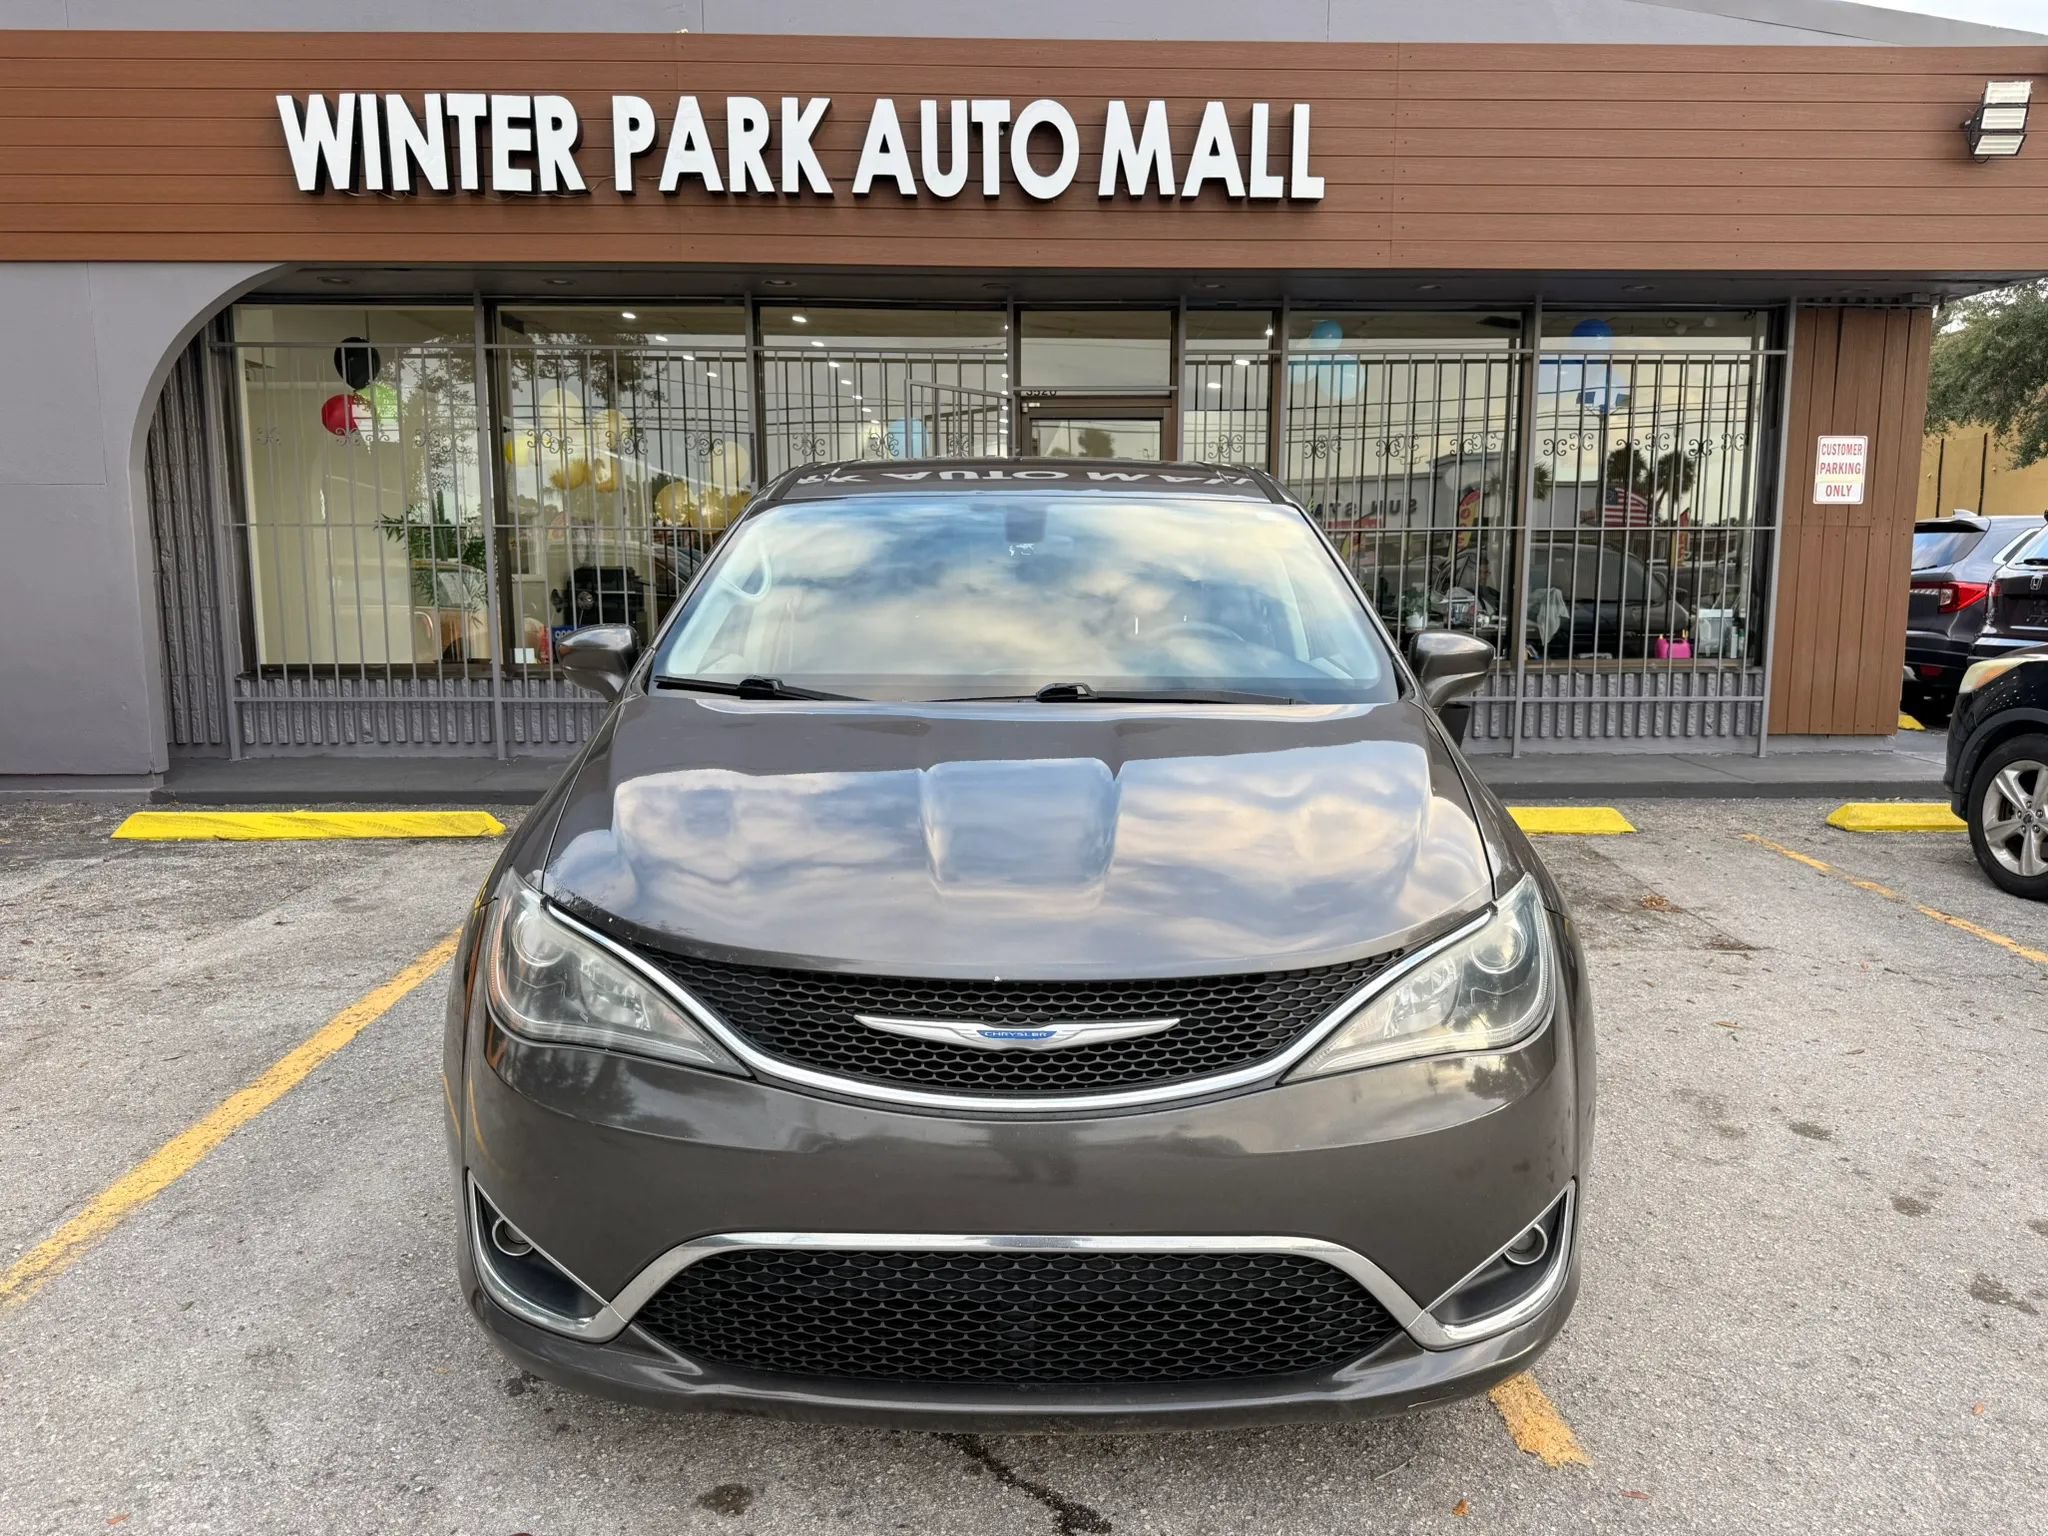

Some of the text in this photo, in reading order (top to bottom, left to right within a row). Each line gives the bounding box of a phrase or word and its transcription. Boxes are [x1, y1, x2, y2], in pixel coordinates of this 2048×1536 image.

[275, 93, 1326, 200] WINTER PARK AUTO MALL
[1821, 443, 1863, 456] CUSTOMER
[1819, 462, 1861, 475] PARKING
[1825, 484, 1853, 497] ONLY
